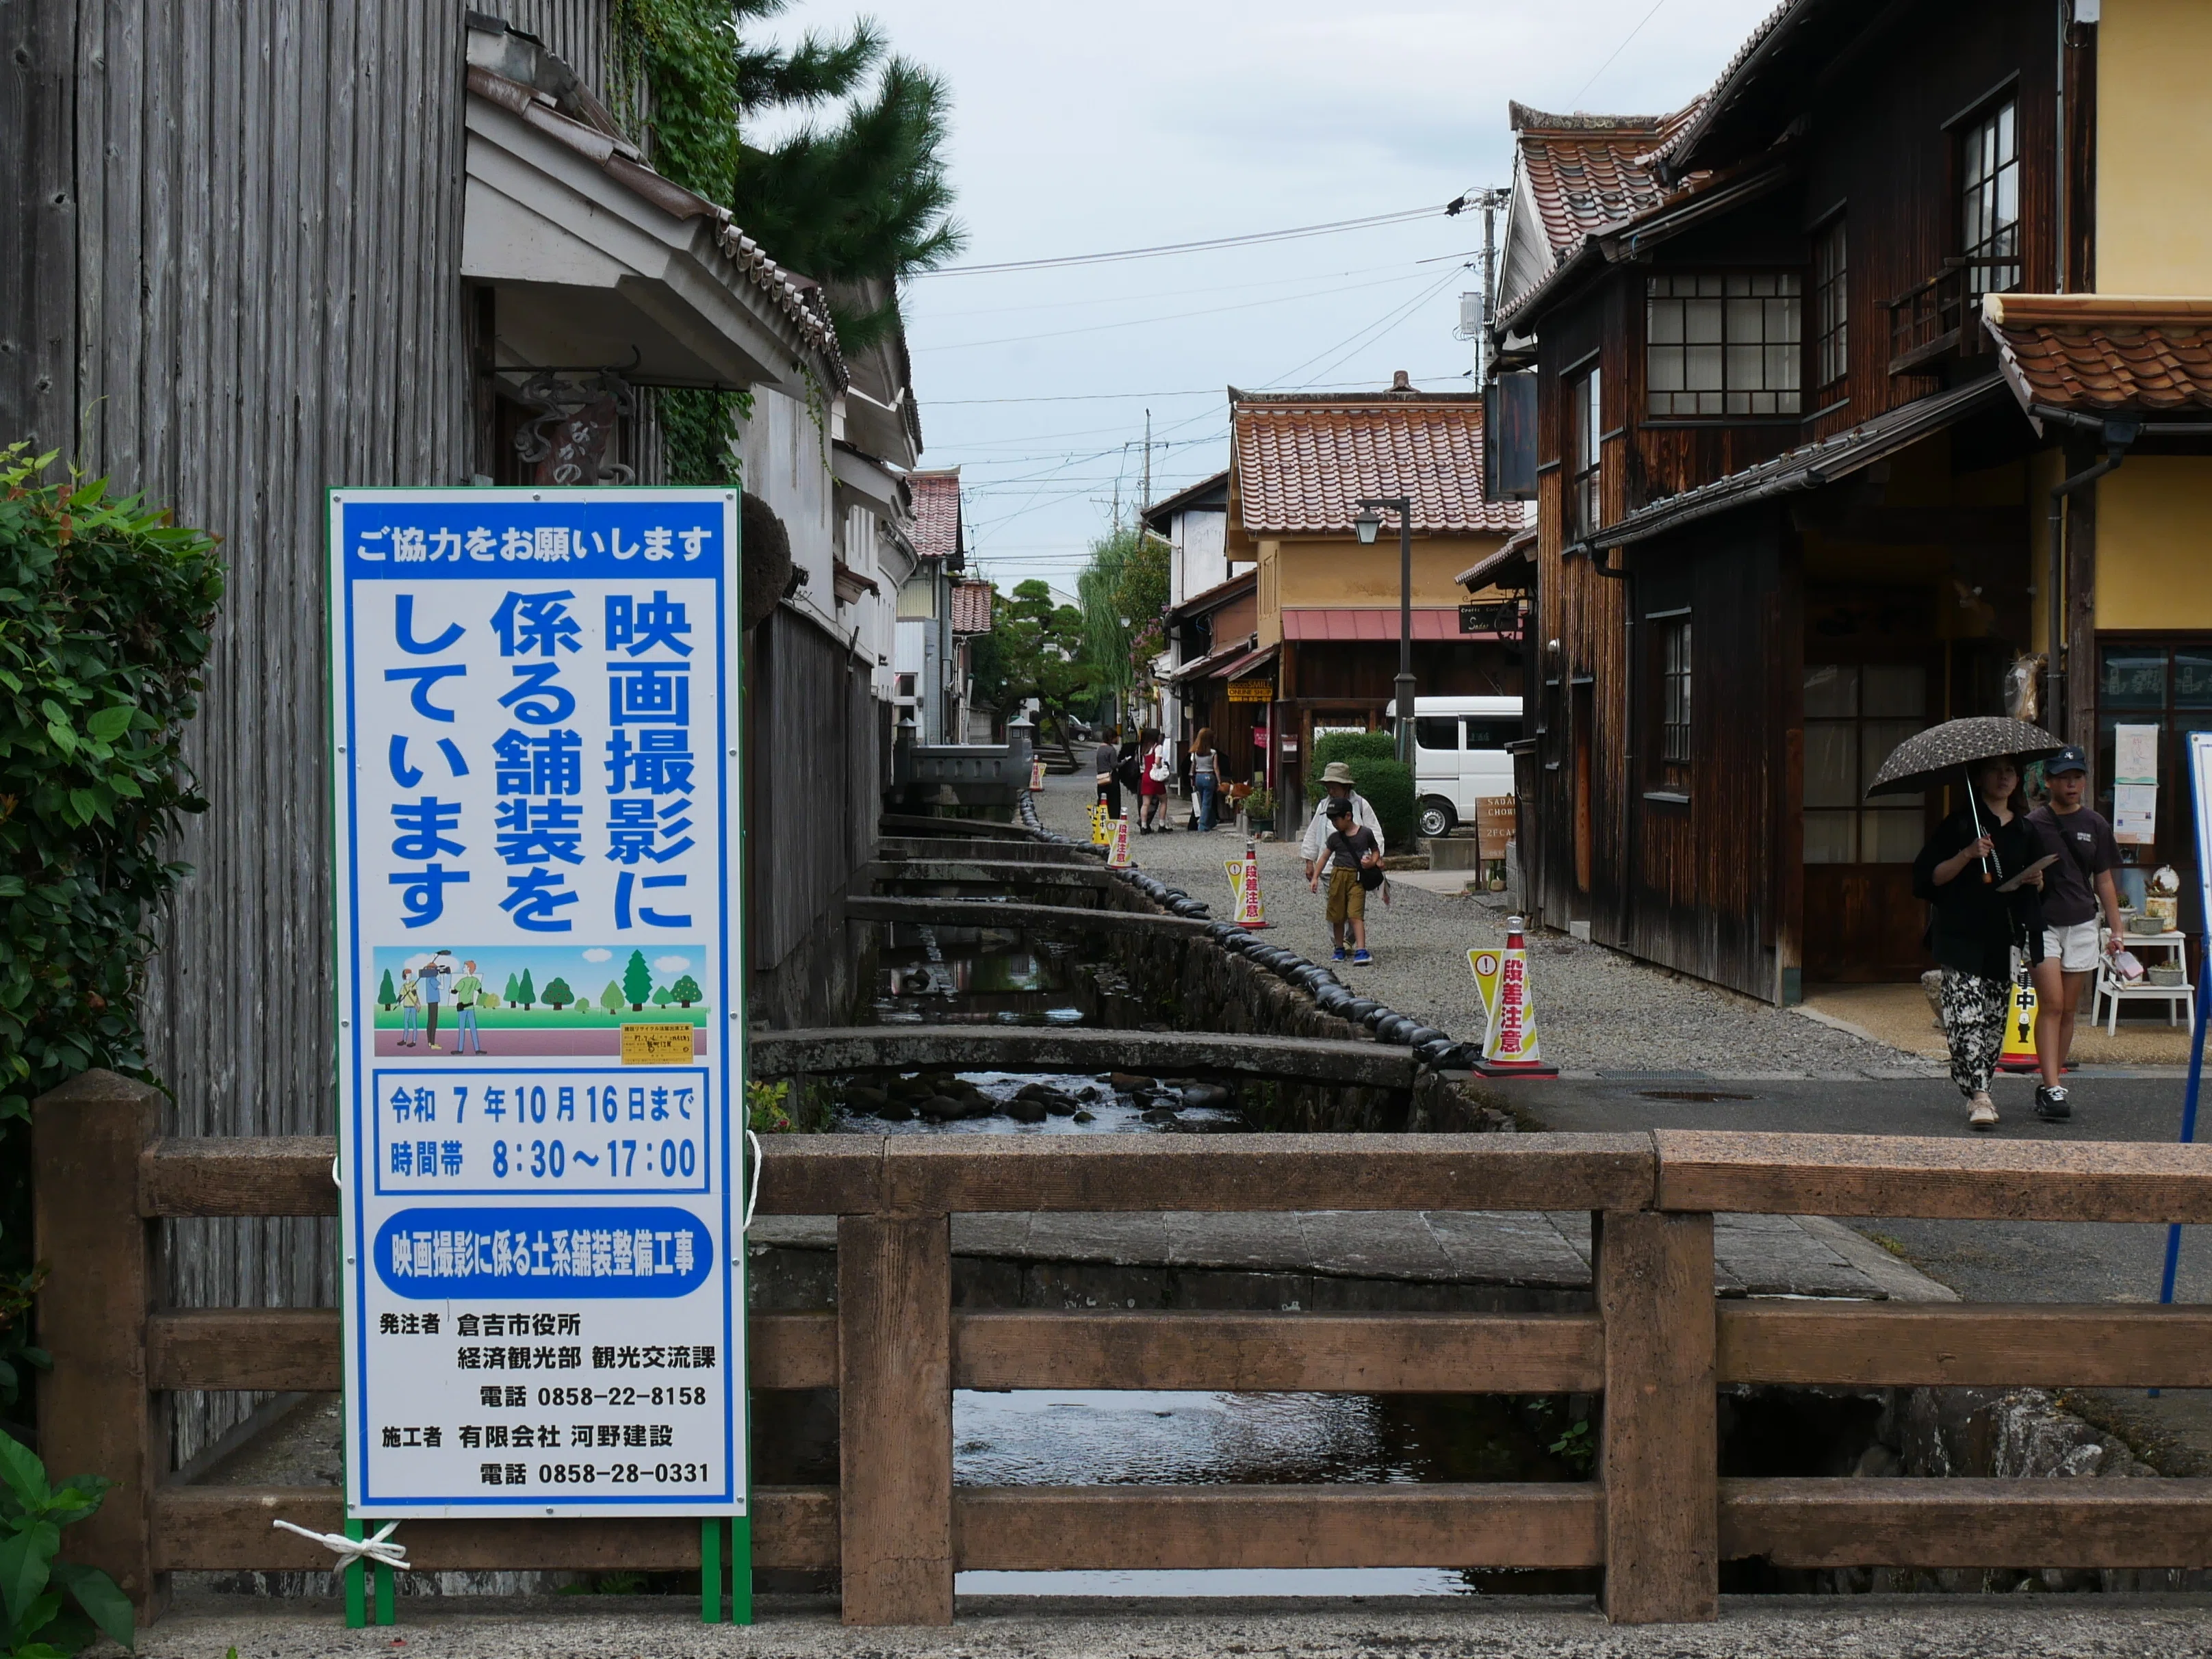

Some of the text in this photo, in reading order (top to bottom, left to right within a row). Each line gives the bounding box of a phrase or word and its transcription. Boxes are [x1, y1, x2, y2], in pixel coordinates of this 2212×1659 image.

[358, 526, 711, 561] ご協力をお願いします
[385, 595, 470, 928] しています
[490, 590, 585, 932] 係る舗装を
[604, 591, 695, 929] 映画撮影に
[1246, 865, 1259, 918] 段差注意
[1500, 959, 1524, 1053] 段差注意
[391, 1140, 463, 1176] 時間帯
[393, 1230, 693, 1277] 映画撮影に係る土系舗装整備工事
[381, 1313, 580, 1336] 発注者 倉吉市役所
[458, 1346, 715, 1369] 経済観光部 観光交流課
[480, 1386, 705, 1407] 電話 0858-22-8158
[383, 1425, 672, 1448] 施工者 有限会社 河野建設
[480, 1463, 706, 1484] 電話 0858-28-0331
